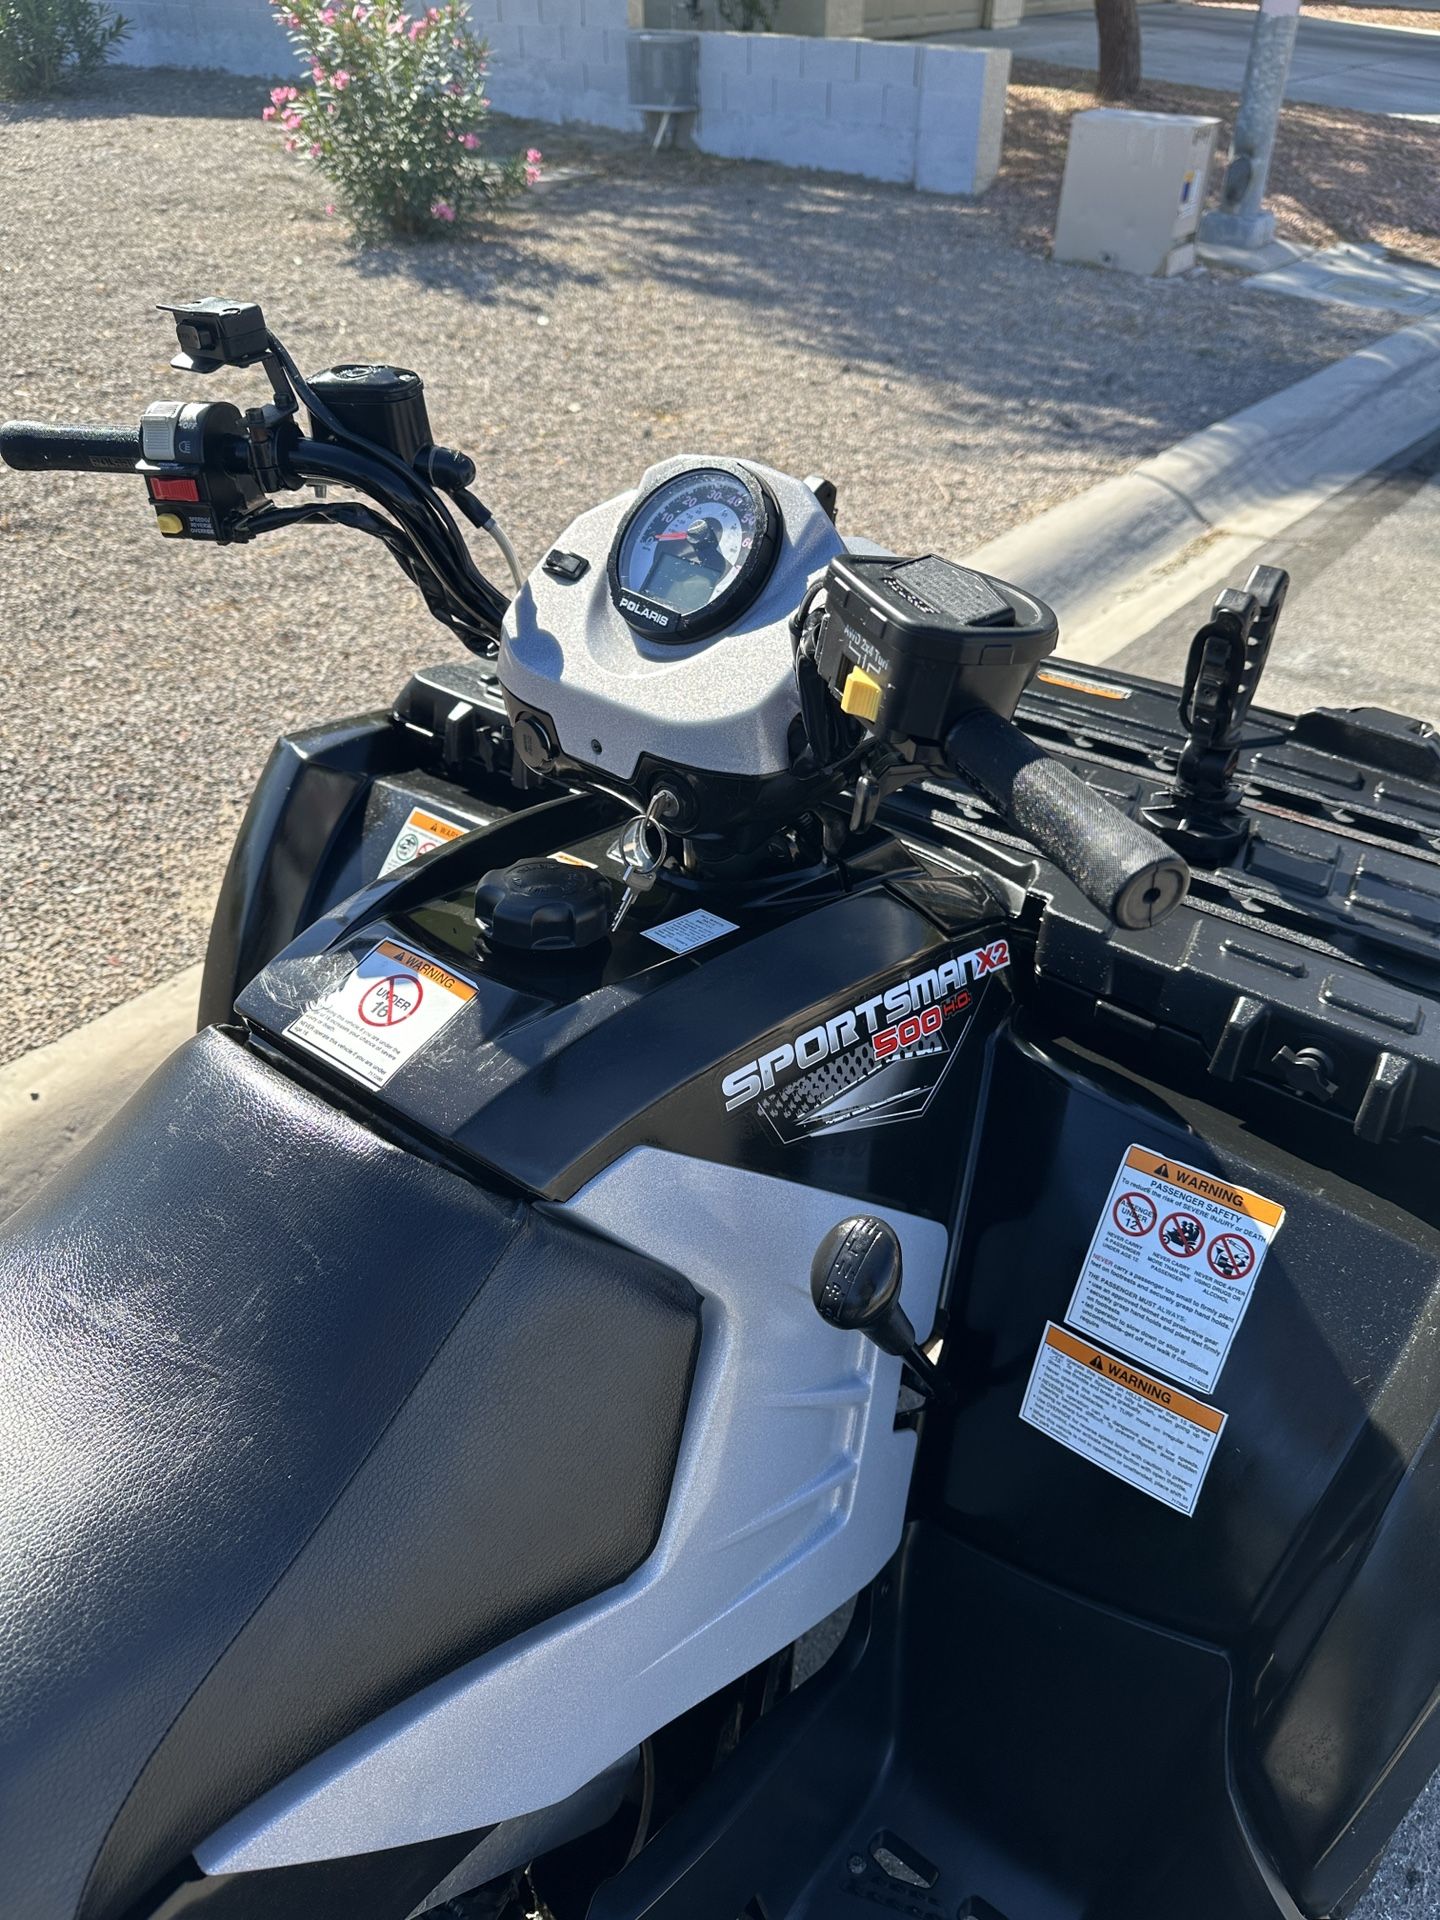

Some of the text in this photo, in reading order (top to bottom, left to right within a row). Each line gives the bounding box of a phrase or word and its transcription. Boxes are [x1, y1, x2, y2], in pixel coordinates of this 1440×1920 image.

[683, 496, 697, 507] 20
[707, 490, 722, 501] 30
[727, 496, 742, 507] 40
[661, 512, 674, 523] 10
[619, 597, 669, 627] POLARIS
[860, 638, 875, 657] 2x4
[404, 956, 455, 988] WARNING
[371, 1001, 390, 1019] 16
[721, 939, 1011, 1112] SPORTSMAN X2
[872, 1005, 943, 1062] 500
[1151, 1180, 1242, 1223] PASSENGER SAFETY
[1177, 1171, 1243, 1206] WARNING
[1122, 1177, 1130, 1185] To
[1130, 1182, 1151, 1193] reduce
[1151, 1190, 1162, 1198] the
[1162, 1195, 1174, 1204] risk
[1183, 1203, 1209, 1218] SEVERE
[1210, 1215, 1234, 1228] INJURY
[1243, 1229, 1266, 1242] DEATH
[1126, 1218, 1139, 1230] 12
[1107, 1231, 1143, 1250] NEVER CARRY
[1109, 1239, 1141, 1256] PASSENGER
[1147, 1256, 1191, 1279] MORE THAN ONE
[1150, 1265, 1183, 1282] PASSENGER
[1152, 1252, 1190, 1271] NEVER CARRY
[1088, 1271, 1100, 1281] THE
[1101, 1278, 1138, 1299] PASSENGER
[1138, 1296, 1156, 1308] MUST
[1091, 1260, 1102, 1269] feet
[1110, 1269, 1136, 1285] footrests
[1137, 1283, 1149, 1292] and
[1149, 1289, 1175, 1304] securely
[1175, 1301, 1194, 1313] grasp
[1194, 1309, 1211, 1320] hand
[1093, 1253, 1113, 1266] NEVER
[1114, 1264, 1128, 1274] carry
[1133, 1274, 1164, 1290] passenger
[1165, 1287, 1175, 1296] too
[1176, 1293, 1192, 1304] small
[1200, 1303, 1218, 1316] firmly
[1218, 1313, 1234, 1323] plant
[1092, 1282, 1102, 1290] use
[1111, 1292, 1139, 1308] approved
[1139, 1305, 1160, 1318] helmet
[1160, 1316, 1172, 1325] and
[1172, 1322, 1203, 1339] protective
[1204, 1337, 1219, 1346] gear
[1095, 1299, 1120, 1315] footrests
[1089, 1289, 1221, 1357] securely grasp hand holds and plant feet firmly
[1094, 1307, 1118, 1322] operator
[1126, 1323, 1140, 1333] slow
[1141, 1331, 1157, 1342] down
[1166, 1343, 1180, 1353] stop
[1144, 1341, 1156, 1349] and
[1157, 1347, 1170, 1357] walk
[1177, 1357, 1209, 1375] conditions
[1109, 1364, 1171, 1403] WARNING
